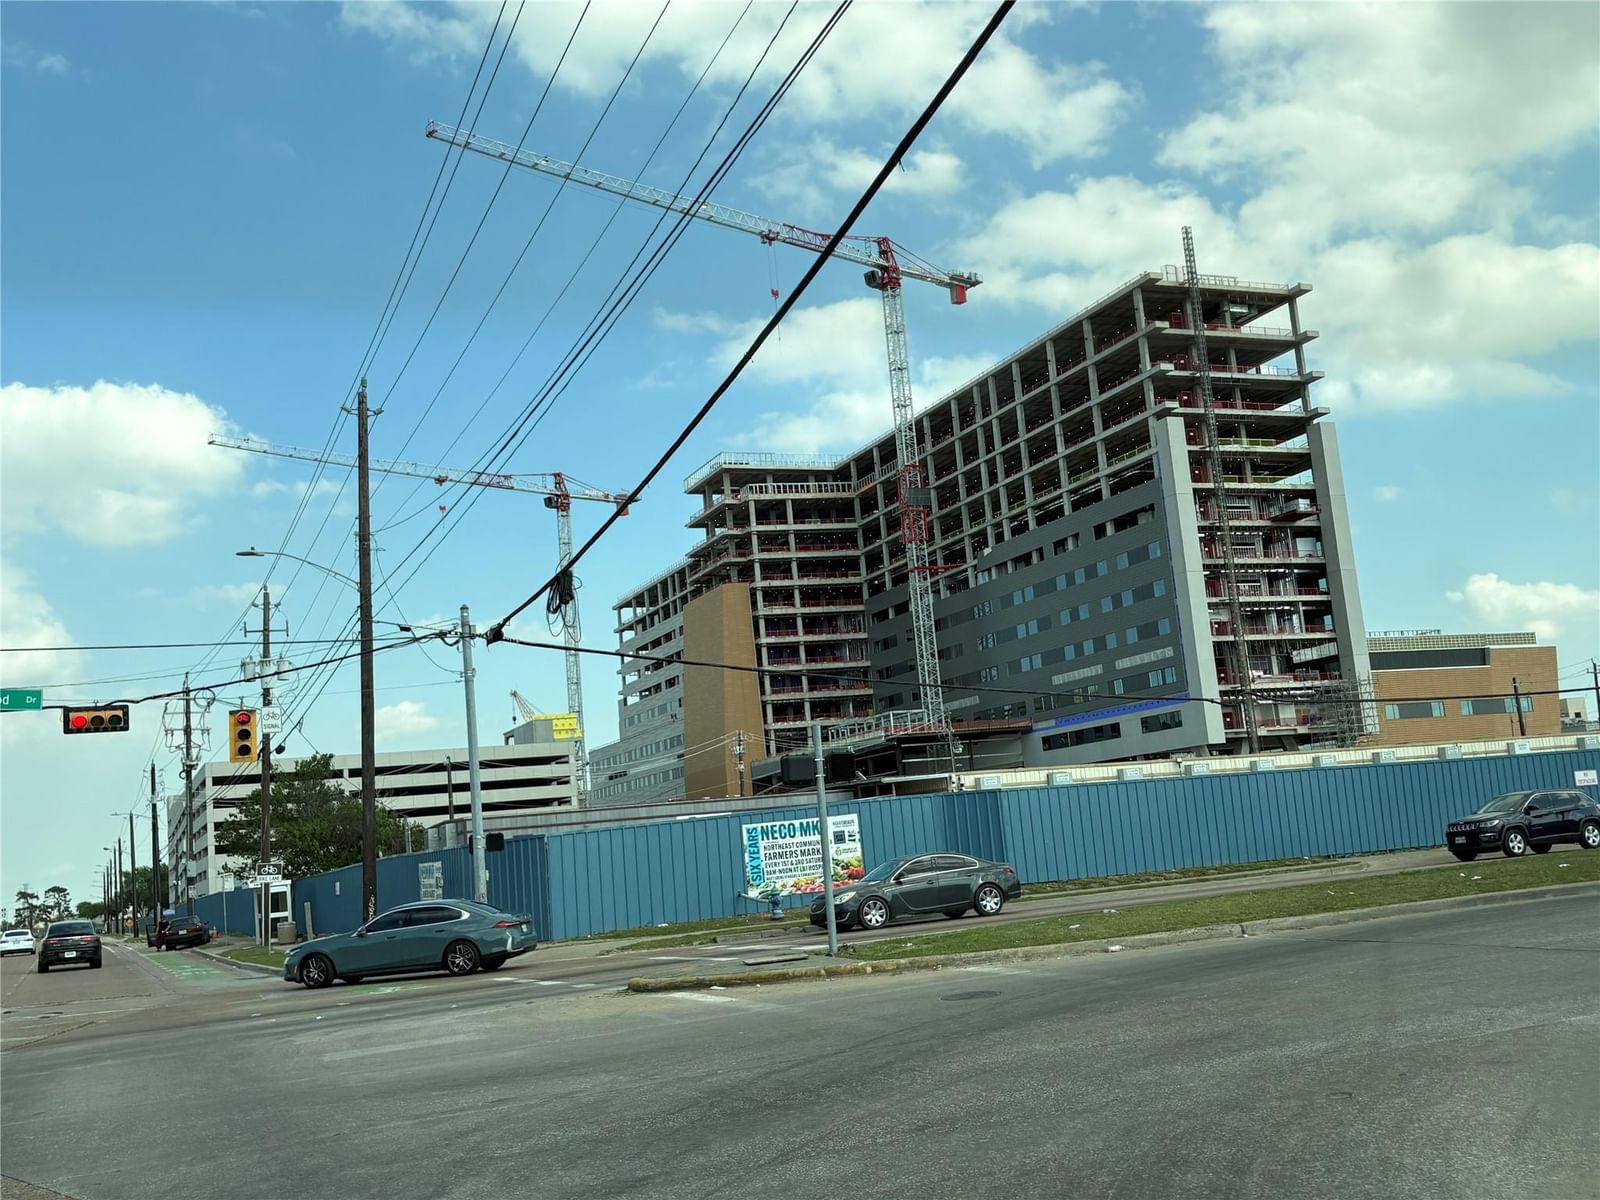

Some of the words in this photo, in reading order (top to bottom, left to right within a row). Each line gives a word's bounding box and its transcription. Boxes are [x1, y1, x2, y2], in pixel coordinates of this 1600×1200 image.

[26, 696, 36, 704] Dr
[760, 823, 796, 841] NECO
[799, 820, 821, 838] MK
[747, 827, 760, 862] YEARS
[763, 842, 795, 851] NORTHEAST
[795, 840, 821, 849] COMMUN
[764, 849, 799, 861] FARMERS
[800, 847, 822, 858] MARK
[765, 861, 780, 869] EVERY
[805, 856, 822, 864] SATUR
[808, 863, 821, 871] HOSP
[750, 864, 762, 882] SIX
